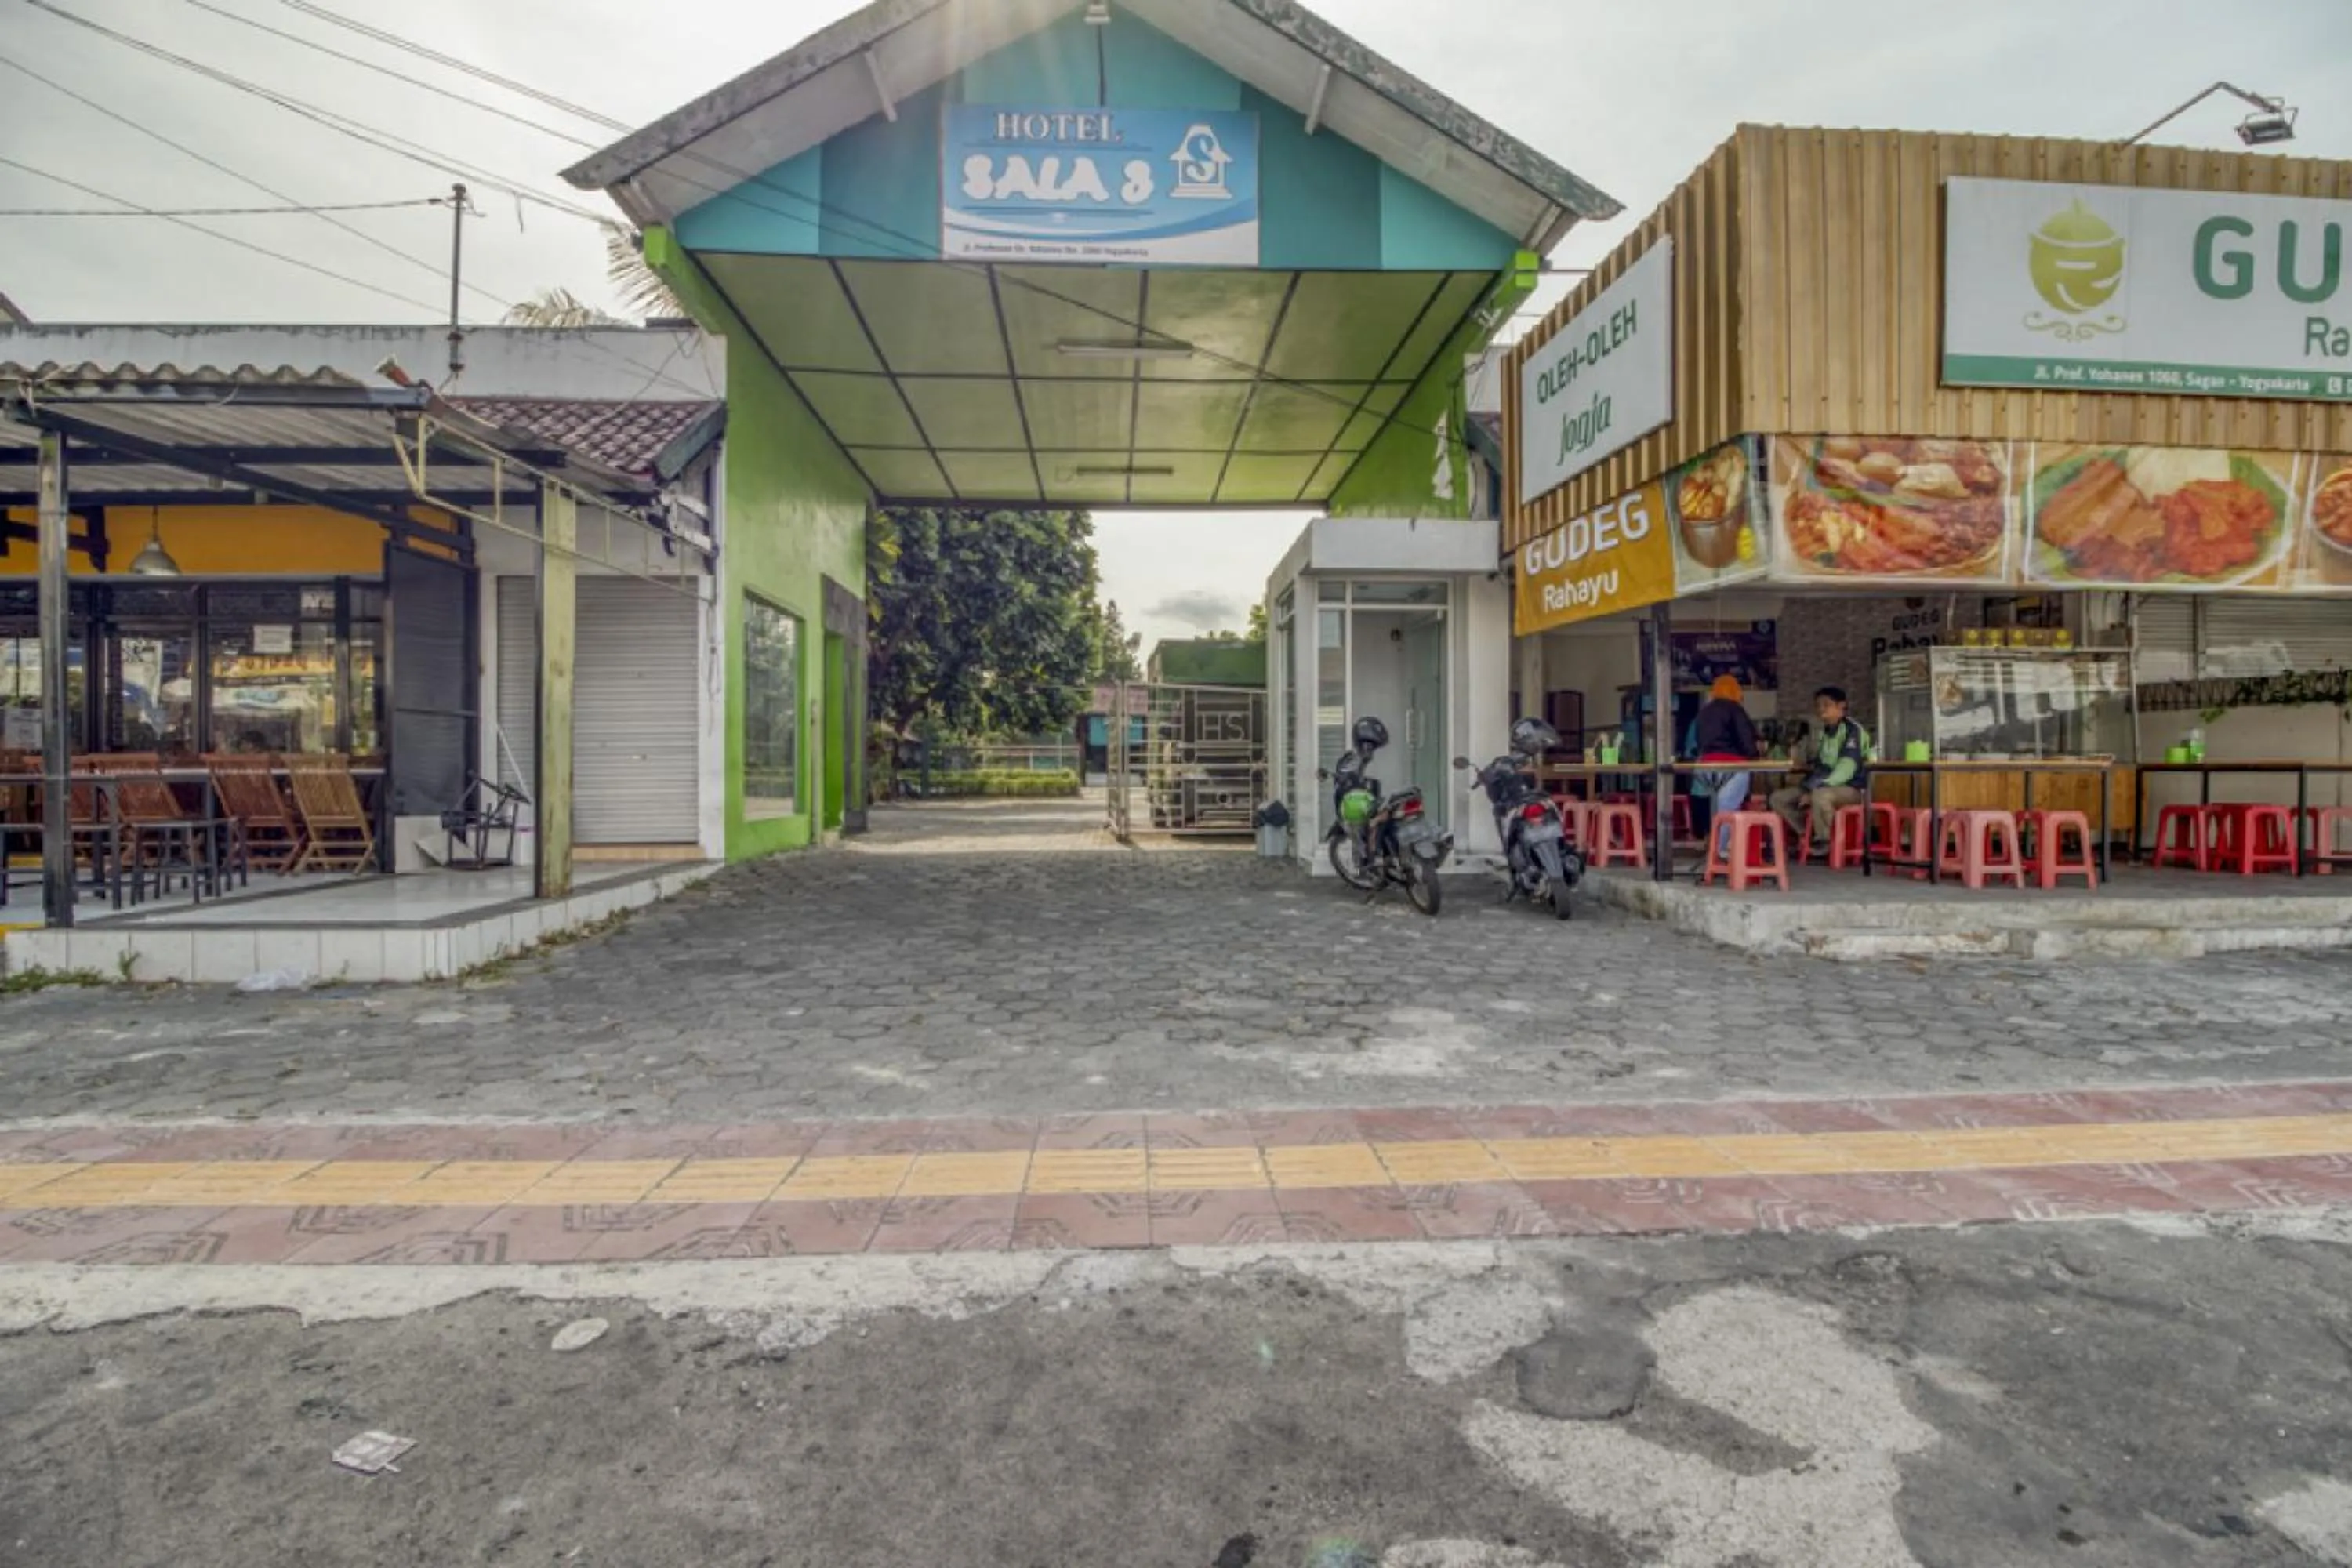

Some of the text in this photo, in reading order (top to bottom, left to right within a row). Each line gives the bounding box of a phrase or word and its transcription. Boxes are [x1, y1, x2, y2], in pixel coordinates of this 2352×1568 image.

[997, 112, 1122, 141] HOTEL
[2193, 216, 2343, 303] GU
[1537, 299, 1637, 405] OLEH-OLEH
[2304, 316, 2350, 357] Ra
[1525, 493, 1648, 575] GUDEG
[1544, 568, 1618, 614] Rahayu
